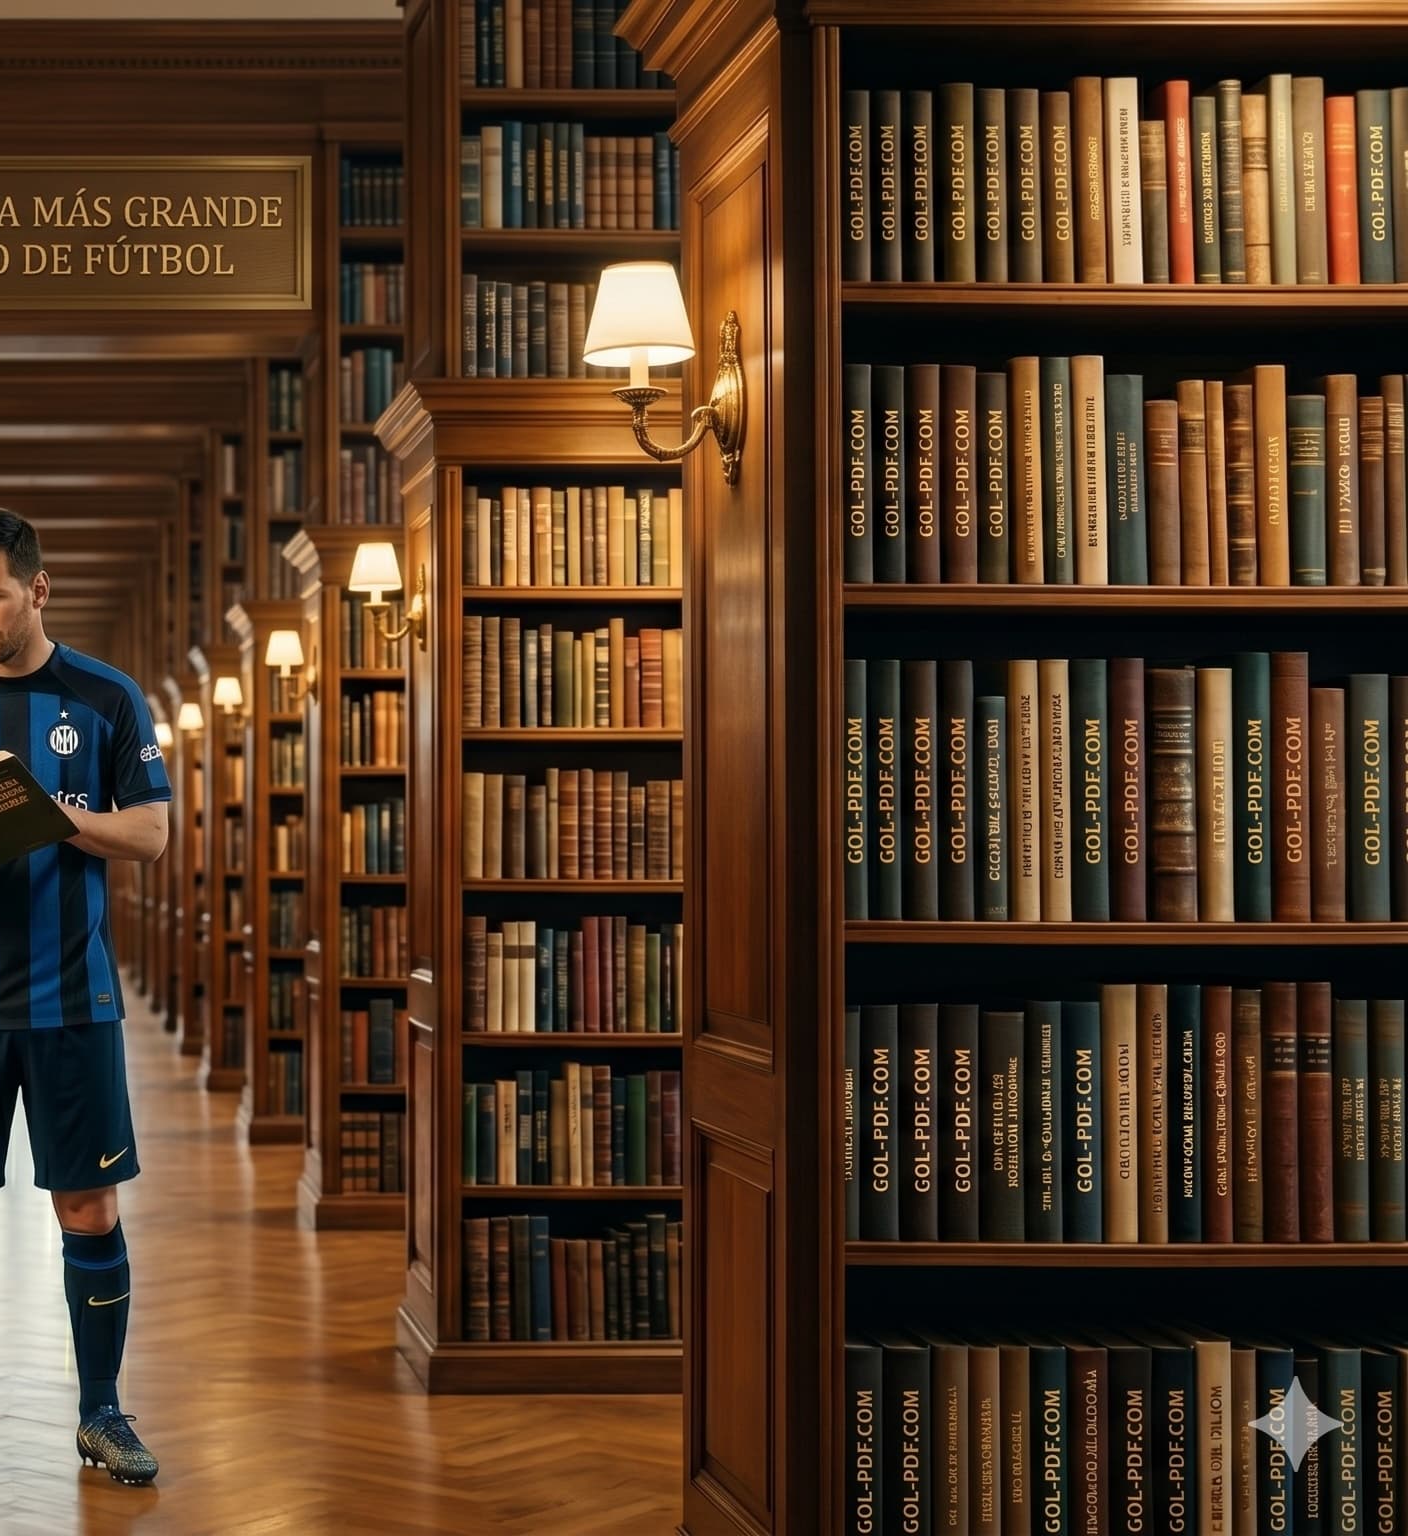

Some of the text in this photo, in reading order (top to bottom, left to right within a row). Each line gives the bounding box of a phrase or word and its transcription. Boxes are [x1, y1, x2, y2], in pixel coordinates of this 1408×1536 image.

[32, 187, 112, 229] MÁS
[123, 195, 283, 229] GRANDE
[1369, 124, 1386, 241] GOL-PDF.COM
[21, 243, 72, 276] DE
[83, 235, 235, 276] FÚTBOL
[850, 409, 865, 537] GOL-PDF.COM
[884, 409, 900, 537] GOL-PDF.COM
[918, 409, 934, 538] GOL-PDF.COM
[954, 409, 970, 537] GOL-PDF.COM
[988, 410, 1004, 538] GOL-PDF.COM
[847, 717, 864, 864] GOL-PDF.COM
[878, 717, 896, 864] GOL-PDF.COM
[914, 717, 932, 864] GOL-PDF.COM
[950, 717, 967, 864] GOL-PDF.COM
[1084, 718, 1102, 864] GOL-PDF.COM
[1123, 719, 1140, 864] GOL-PDF.COM
[1247, 719, 1263, 864] GOL-PDF.COM
[1285, 716, 1303, 863] GOL-PDF.COM
[1363, 719, 1381, 865] GOL-PDF.COM
[872, 1048, 889, 1193] GOL-PDF.COM
[913, 1048, 931, 1193] GOL-PDF.COM
[954, 1049, 971, 1193] GOL-PDF.COM
[1075, 1049, 1093, 1193] GOL-PDF.COM
[856, 1390, 873, 1534] GOL-PDF.COM
[902, 1390, 920, 1534] GOL-PDF.COM
[1043, 1389, 1061, 1533] GOL-PDF.COM
[1126, 1389, 1143, 1533] GOL-PDF.COM
[1168, 1389, 1185, 1533] GOL-PDF.COM
[1341, 1389, 1357, 1532] GOL-PDF.COM
[1376, 1390, 1394, 1534] GOL-PDF.COM
